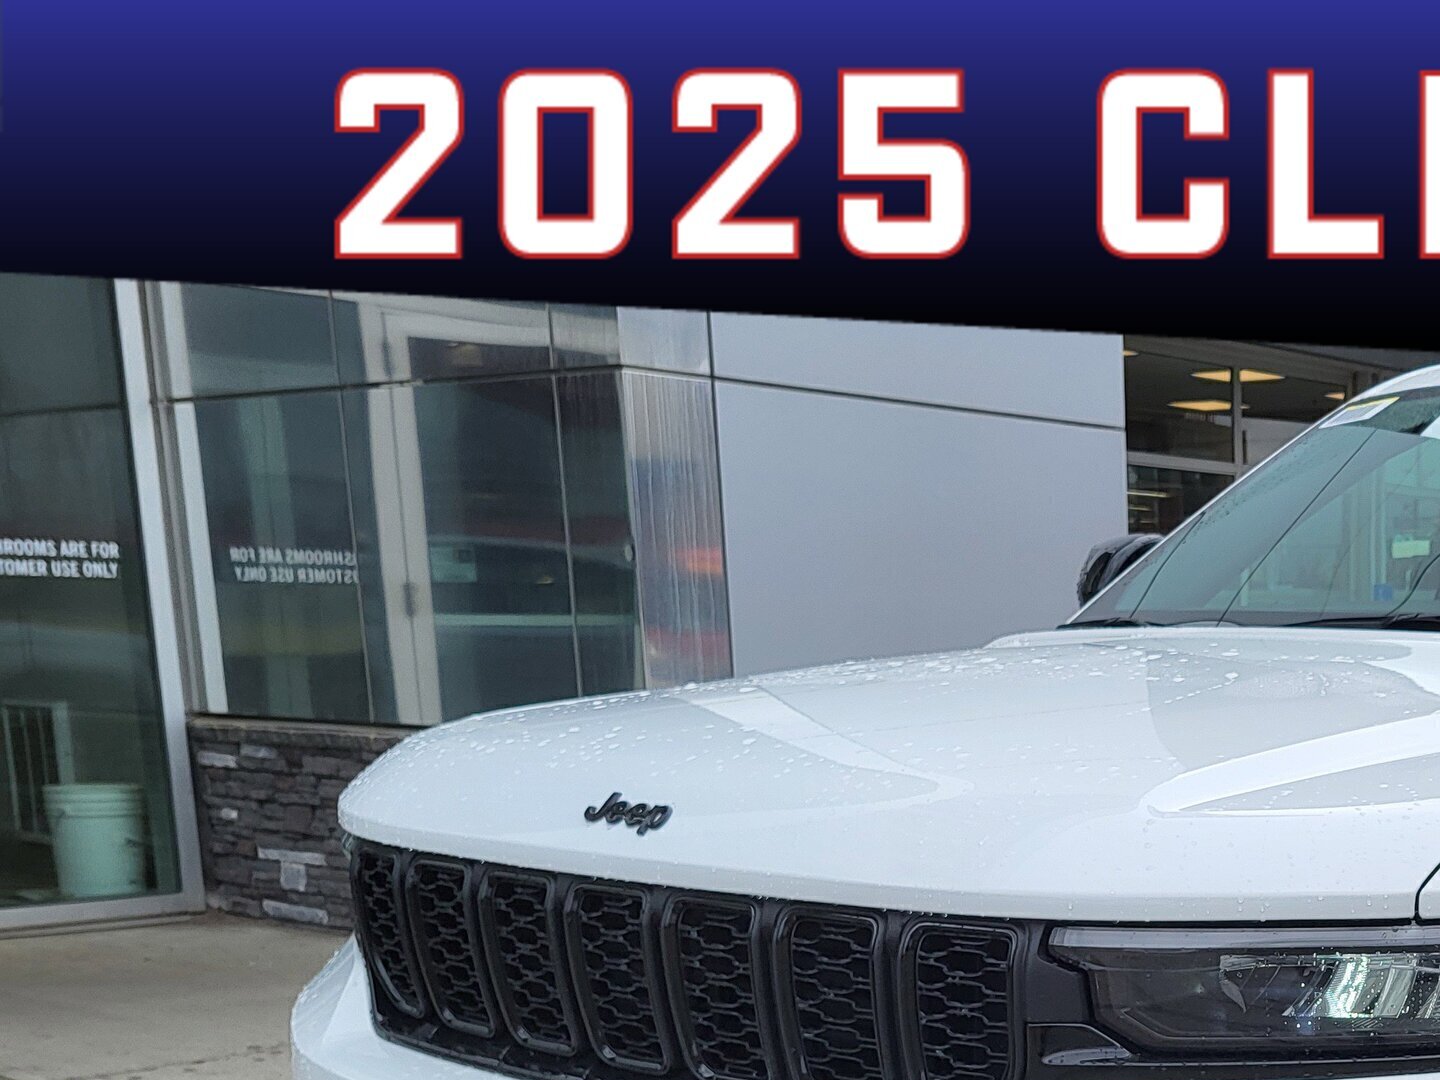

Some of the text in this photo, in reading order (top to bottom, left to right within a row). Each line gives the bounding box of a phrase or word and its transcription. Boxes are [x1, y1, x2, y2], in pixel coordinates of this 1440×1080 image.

[60, 538, 89, 559] ARE
[90, 540, 120, 559] FOR
[50, 559, 80, 578] USE
[82, 560, 119, 579] ONLY
[583, 791, 674, 836] Jeep
